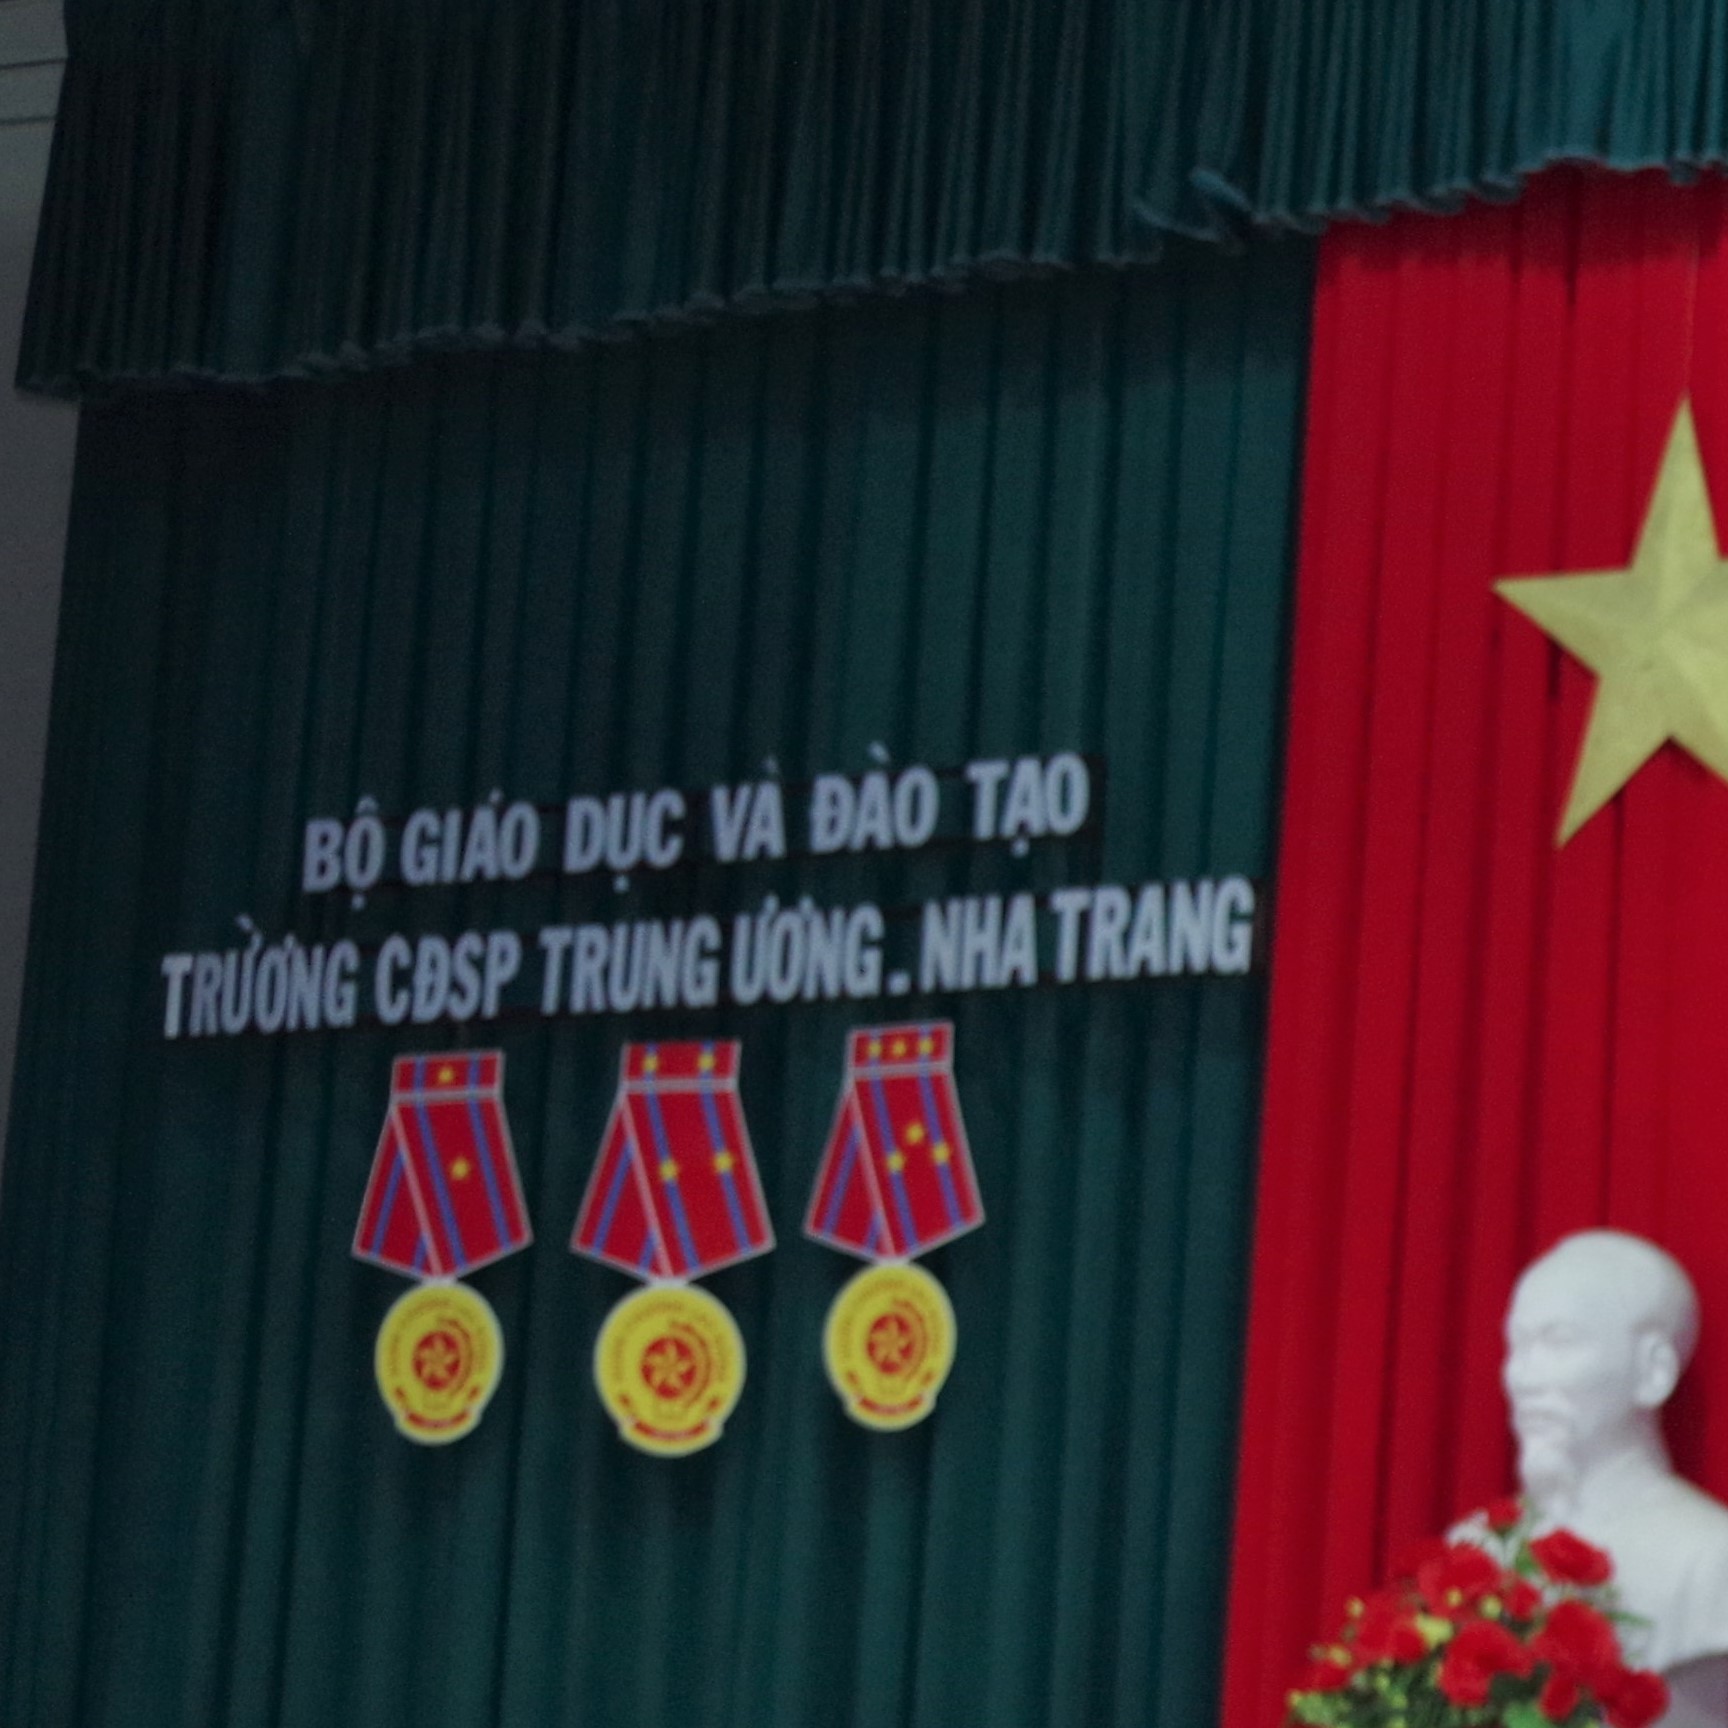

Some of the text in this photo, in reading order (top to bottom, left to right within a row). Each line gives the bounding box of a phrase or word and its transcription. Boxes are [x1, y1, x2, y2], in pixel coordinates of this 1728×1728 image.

[302, 741, 1089, 911] BỘ GIÁO DỤC VÀ ĐÀO TẠO
[161, 915, 358, 1039] TRƯỜNG
[375, 930, 521, 1025] CĐSP
[538, 914, 720, 1015] TRUNG
[1052, 875, 1255, 983] TRANG
